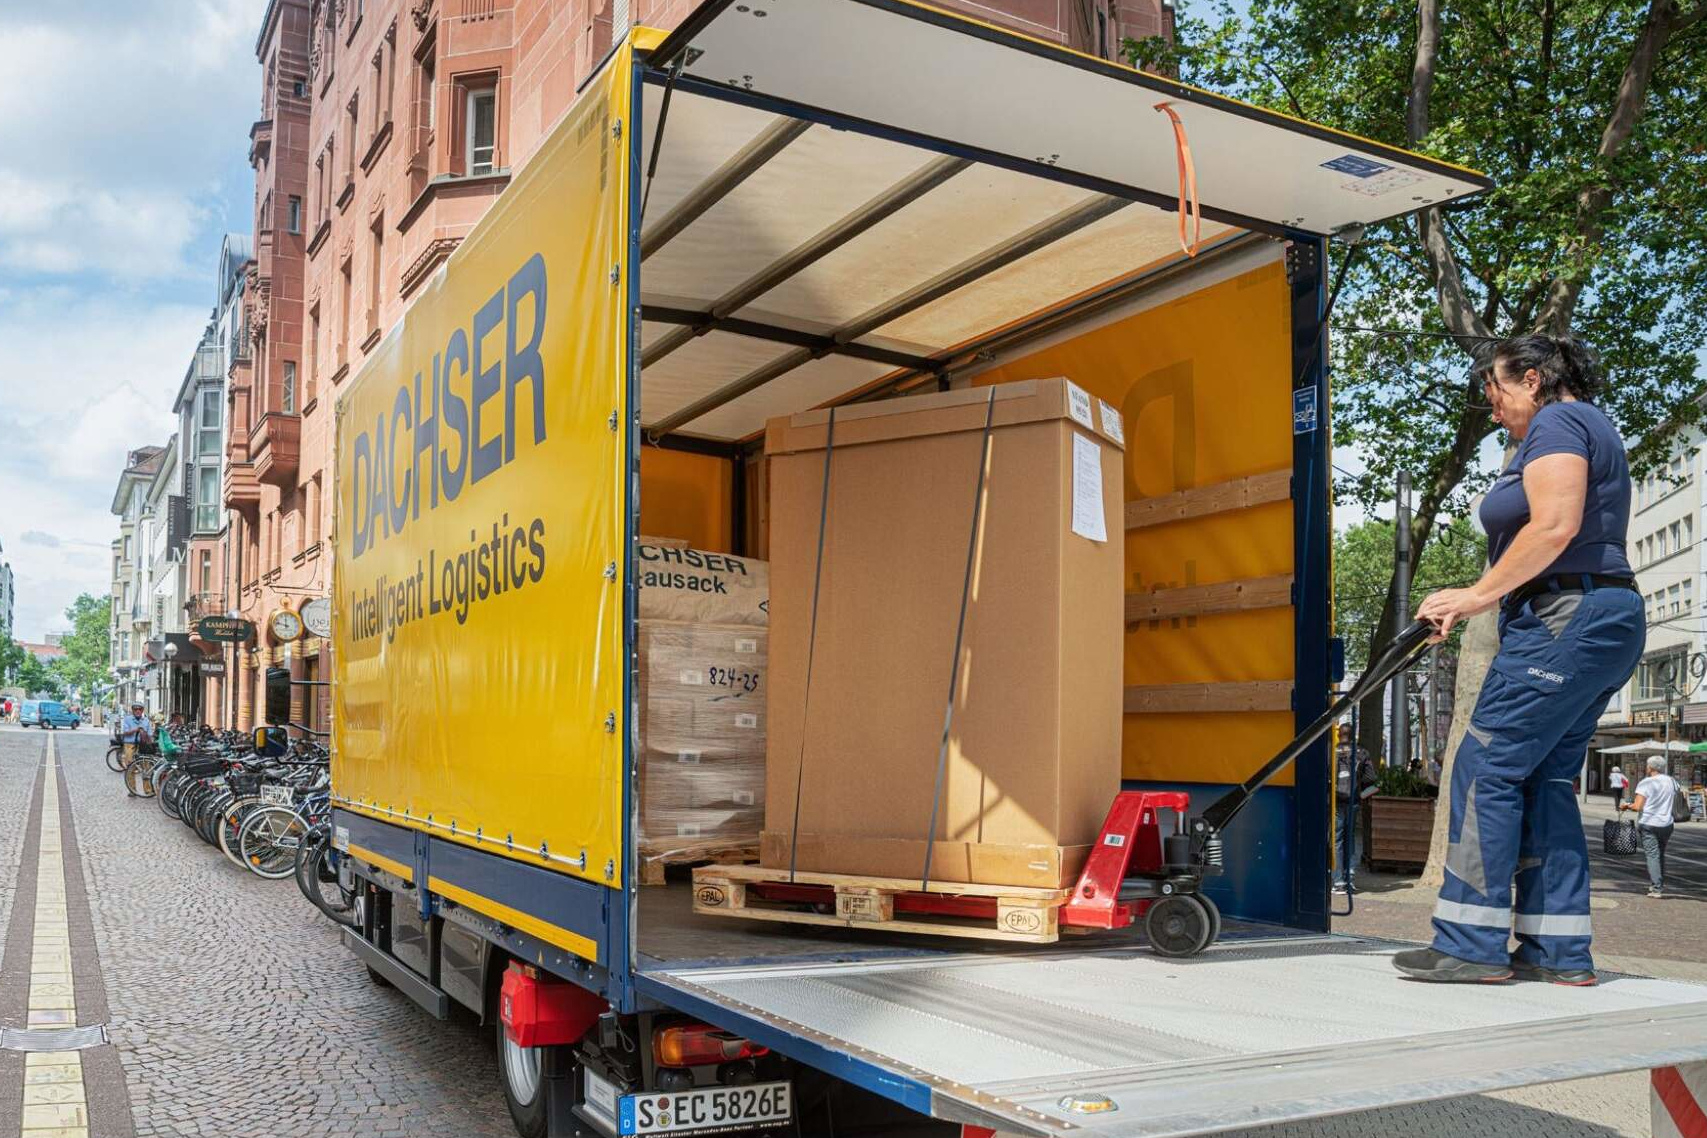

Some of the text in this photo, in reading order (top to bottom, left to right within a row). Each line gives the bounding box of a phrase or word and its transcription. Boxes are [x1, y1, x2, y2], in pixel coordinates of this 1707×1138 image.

[353, 252, 547, 560] DACHSER
[352, 513, 546, 644] Intelligent Logistics
[709, 666, 759, 692] 824-25
[1527, 667, 1564, 684] DACHSER
[701, 890, 720, 902] EPAL
[1011, 914, 1034, 928] EPAL
[638, 1086, 788, 1128] S EC 5826E
[623, 1119, 631, 1129] D
